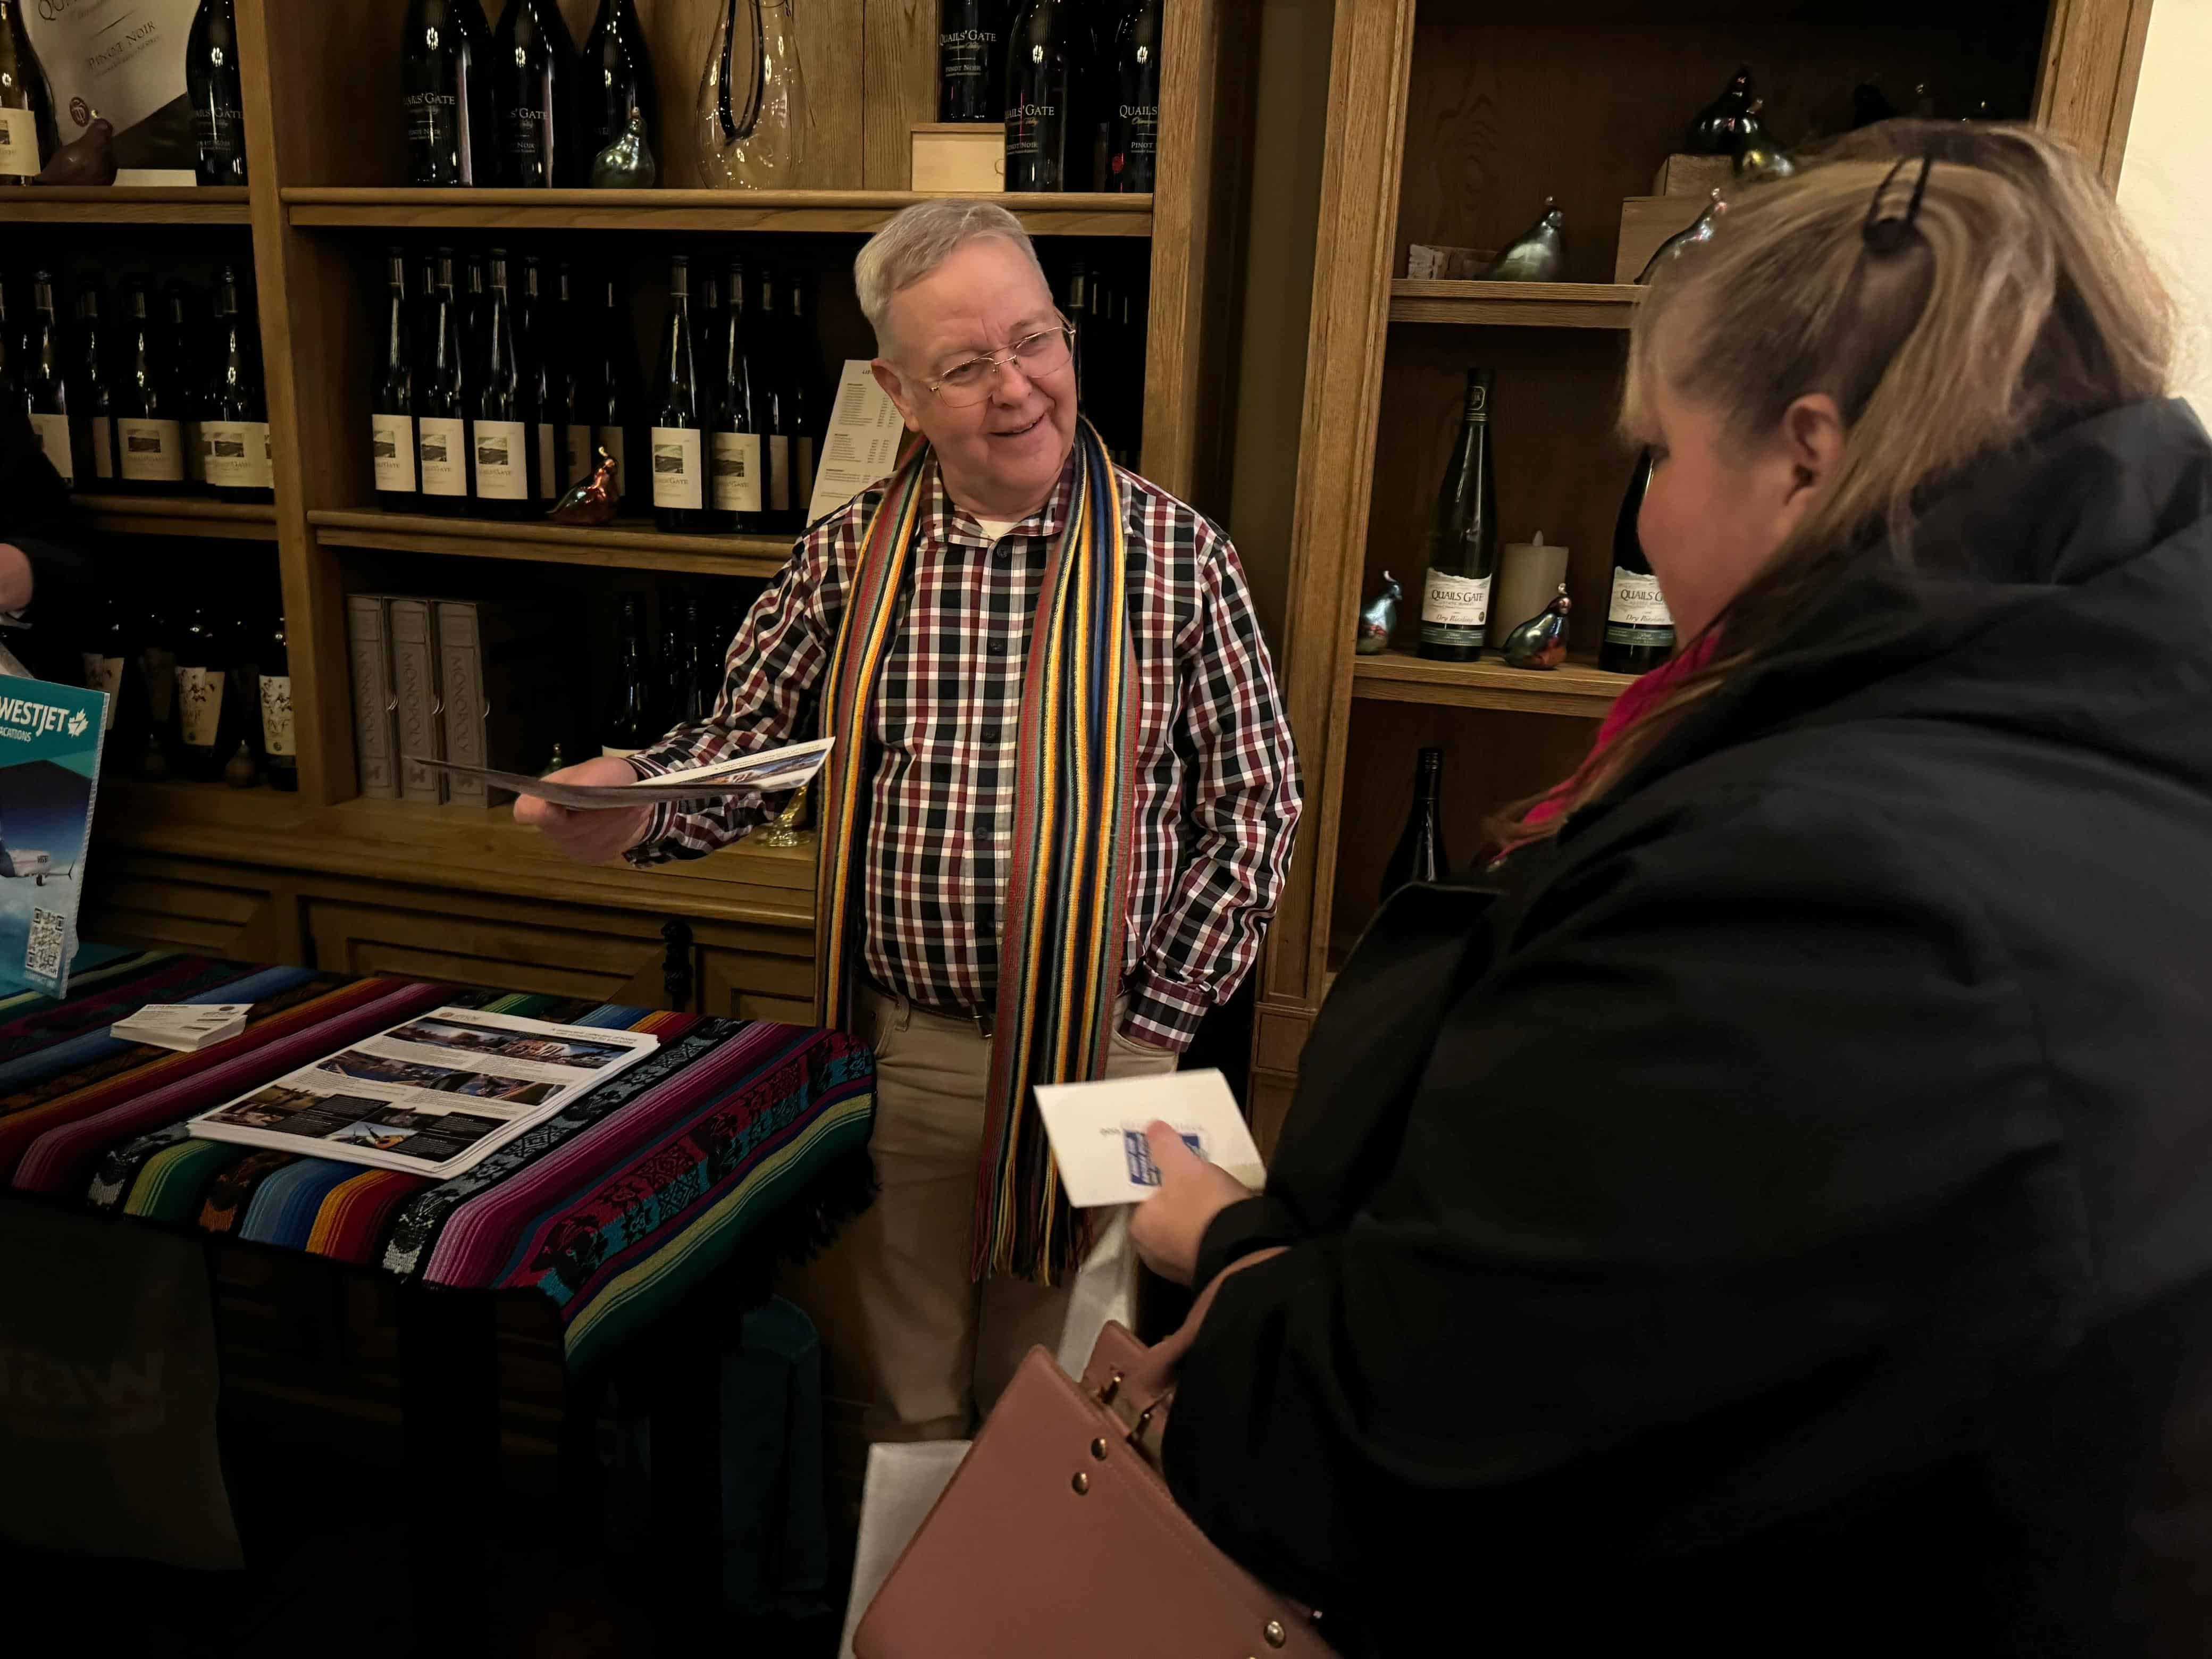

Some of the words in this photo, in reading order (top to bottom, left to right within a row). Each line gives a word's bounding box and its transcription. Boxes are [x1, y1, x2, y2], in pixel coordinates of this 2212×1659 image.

[968, 30, 996, 41] GATE
[89, 41, 124, 70] PINOT
[125, 21, 156, 46] NOIR
[425, 93, 456, 105] GATE
[519, 107, 549, 120] GATE
[1025, 104, 1055, 115] GATE
[1463, 592, 1484, 602] GATE
[403, 652, 422, 748] MONOPOLY
[450, 656, 469, 752] MONOPOLY
[0, 696, 70, 737] WESTJET
[0, 726, 32, 743] ACATIONS
